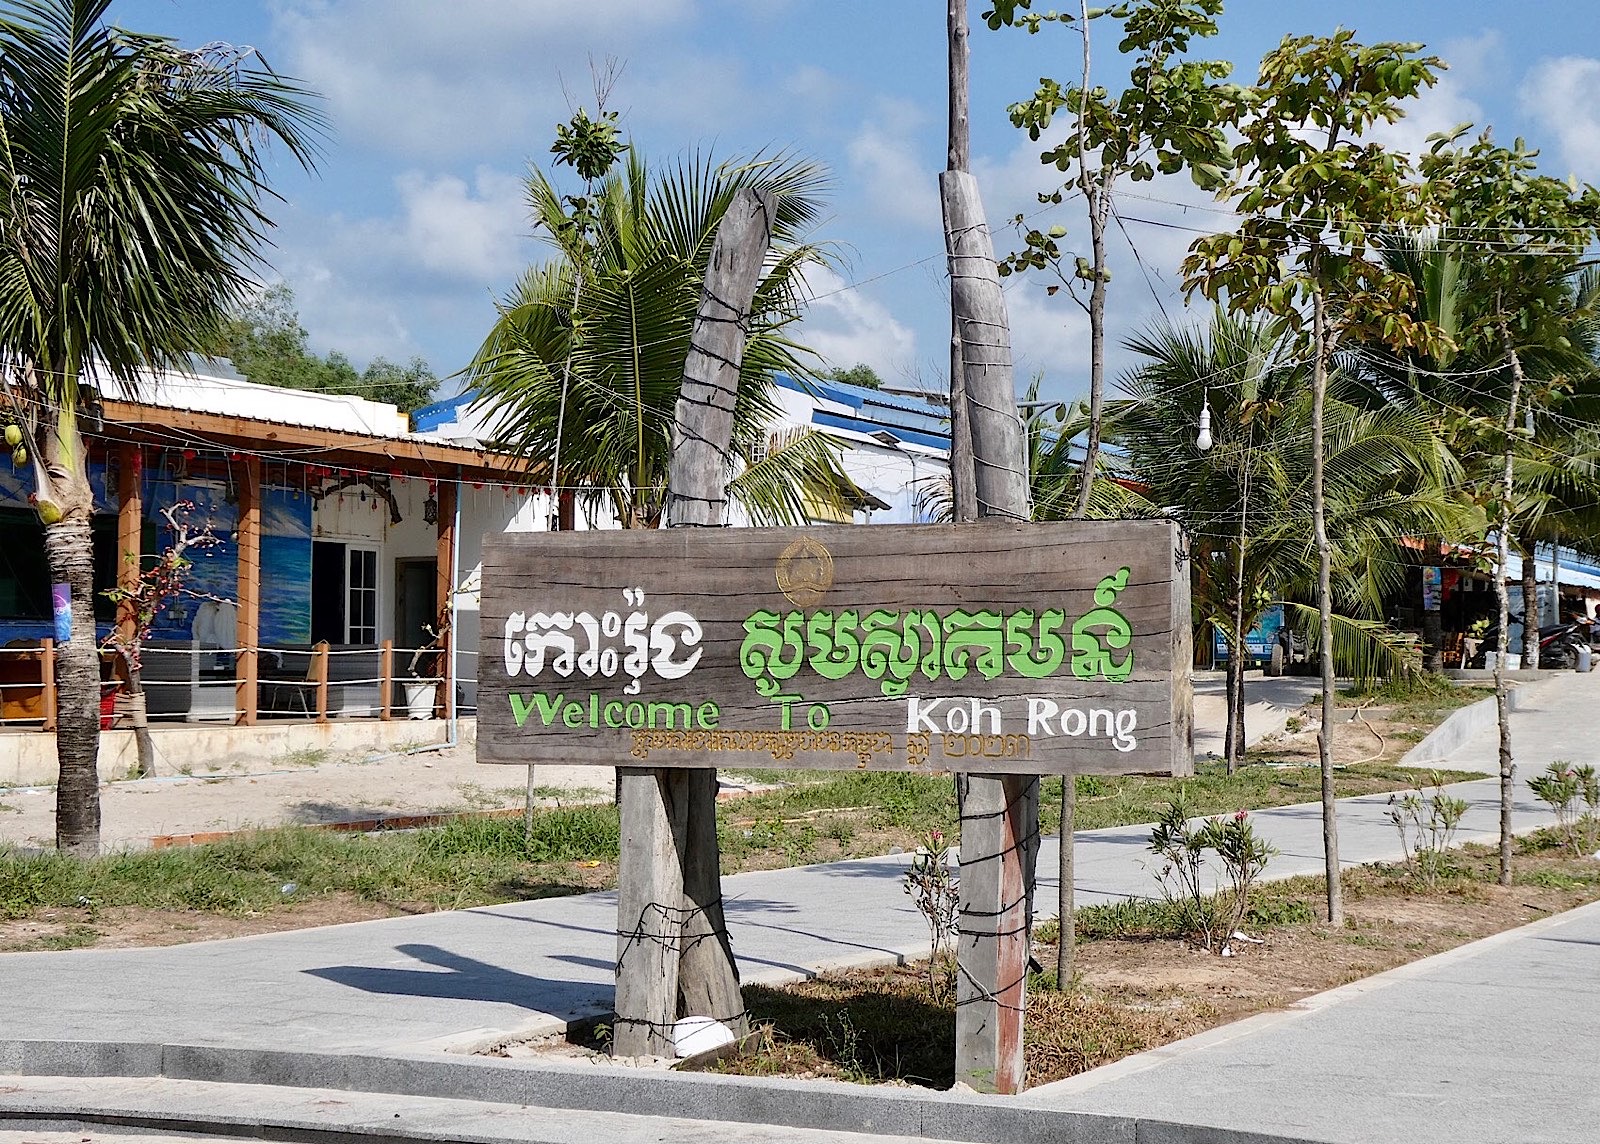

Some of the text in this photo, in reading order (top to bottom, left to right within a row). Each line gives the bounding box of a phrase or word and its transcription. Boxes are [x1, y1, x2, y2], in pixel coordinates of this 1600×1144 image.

[505, 566, 1133, 697] កោះរ៉ុង សូមស្វាគមន៍
[508, 693, 1137, 752] Welcome To Koh Rong
